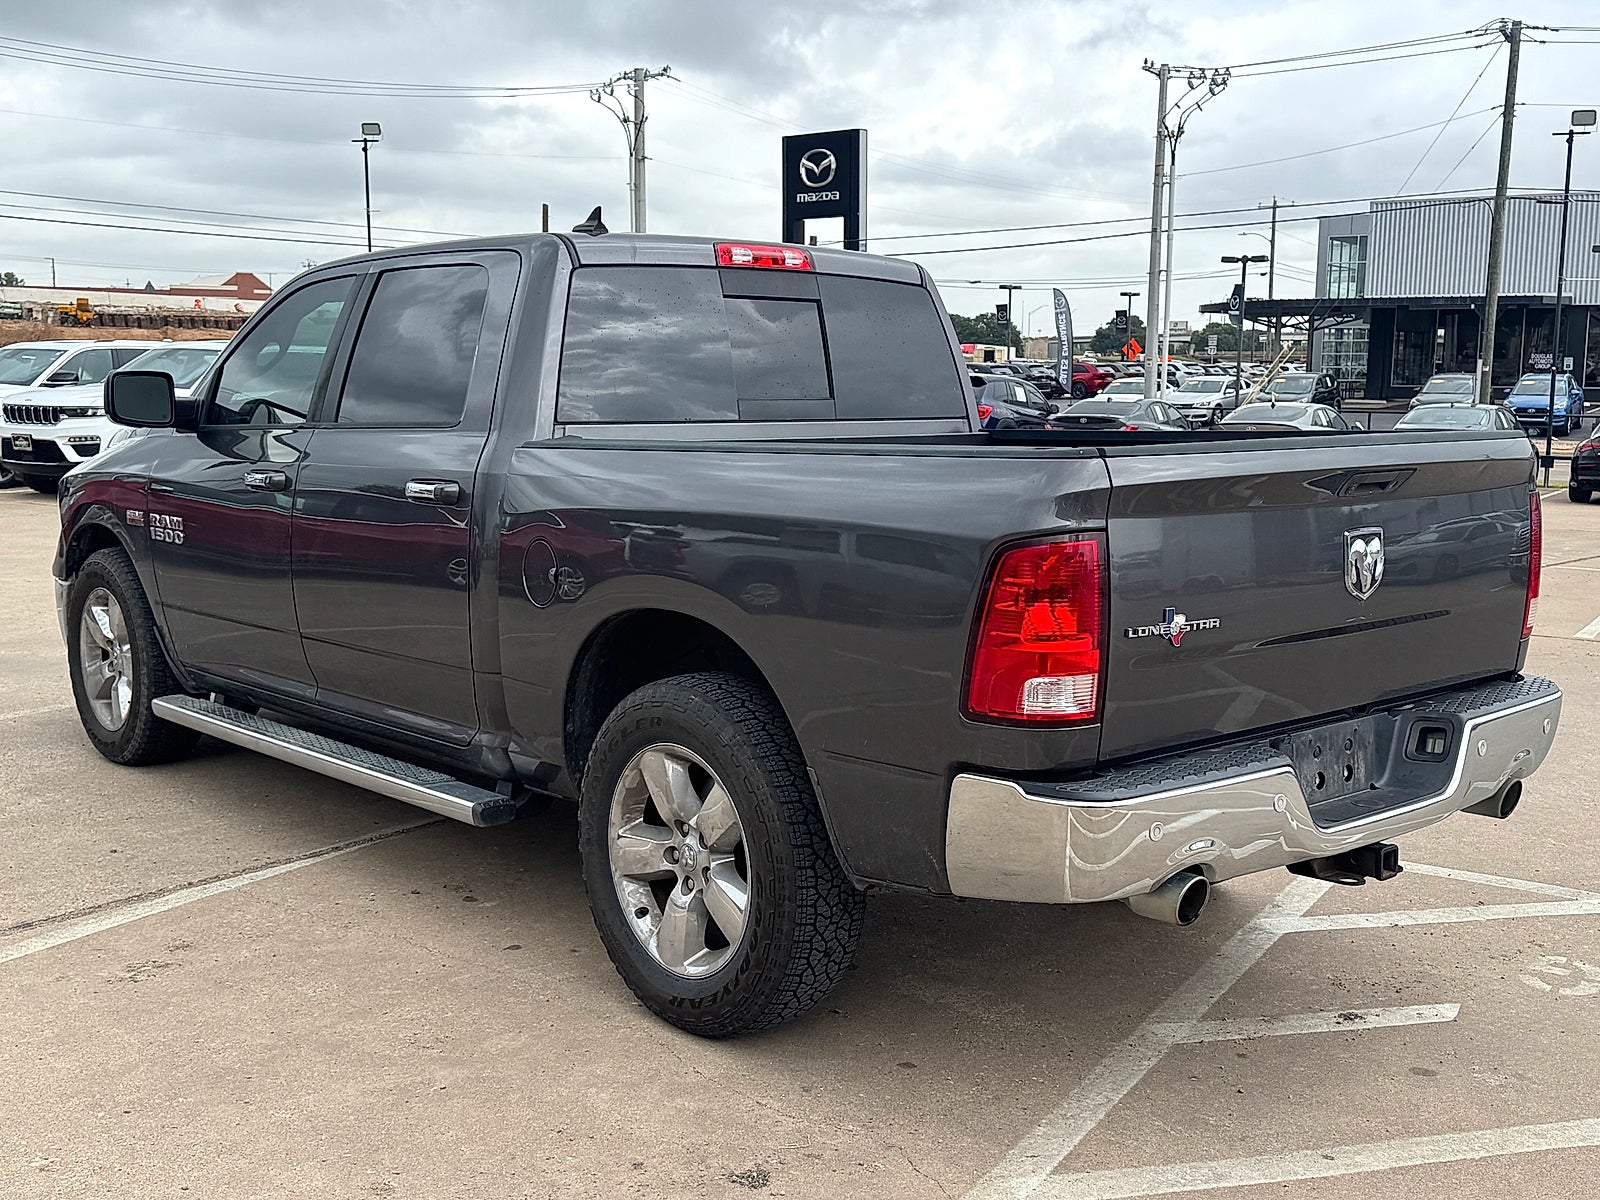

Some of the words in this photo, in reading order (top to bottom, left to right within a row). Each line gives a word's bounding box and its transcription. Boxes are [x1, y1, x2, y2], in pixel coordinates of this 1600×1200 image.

[797, 191, 839, 202] mazda
[150, 513, 184, 530] RAM
[150, 527, 184, 545] 1500
[1126, 623, 1170, 638] LONE
[1181, 618, 1220, 632] STAR
